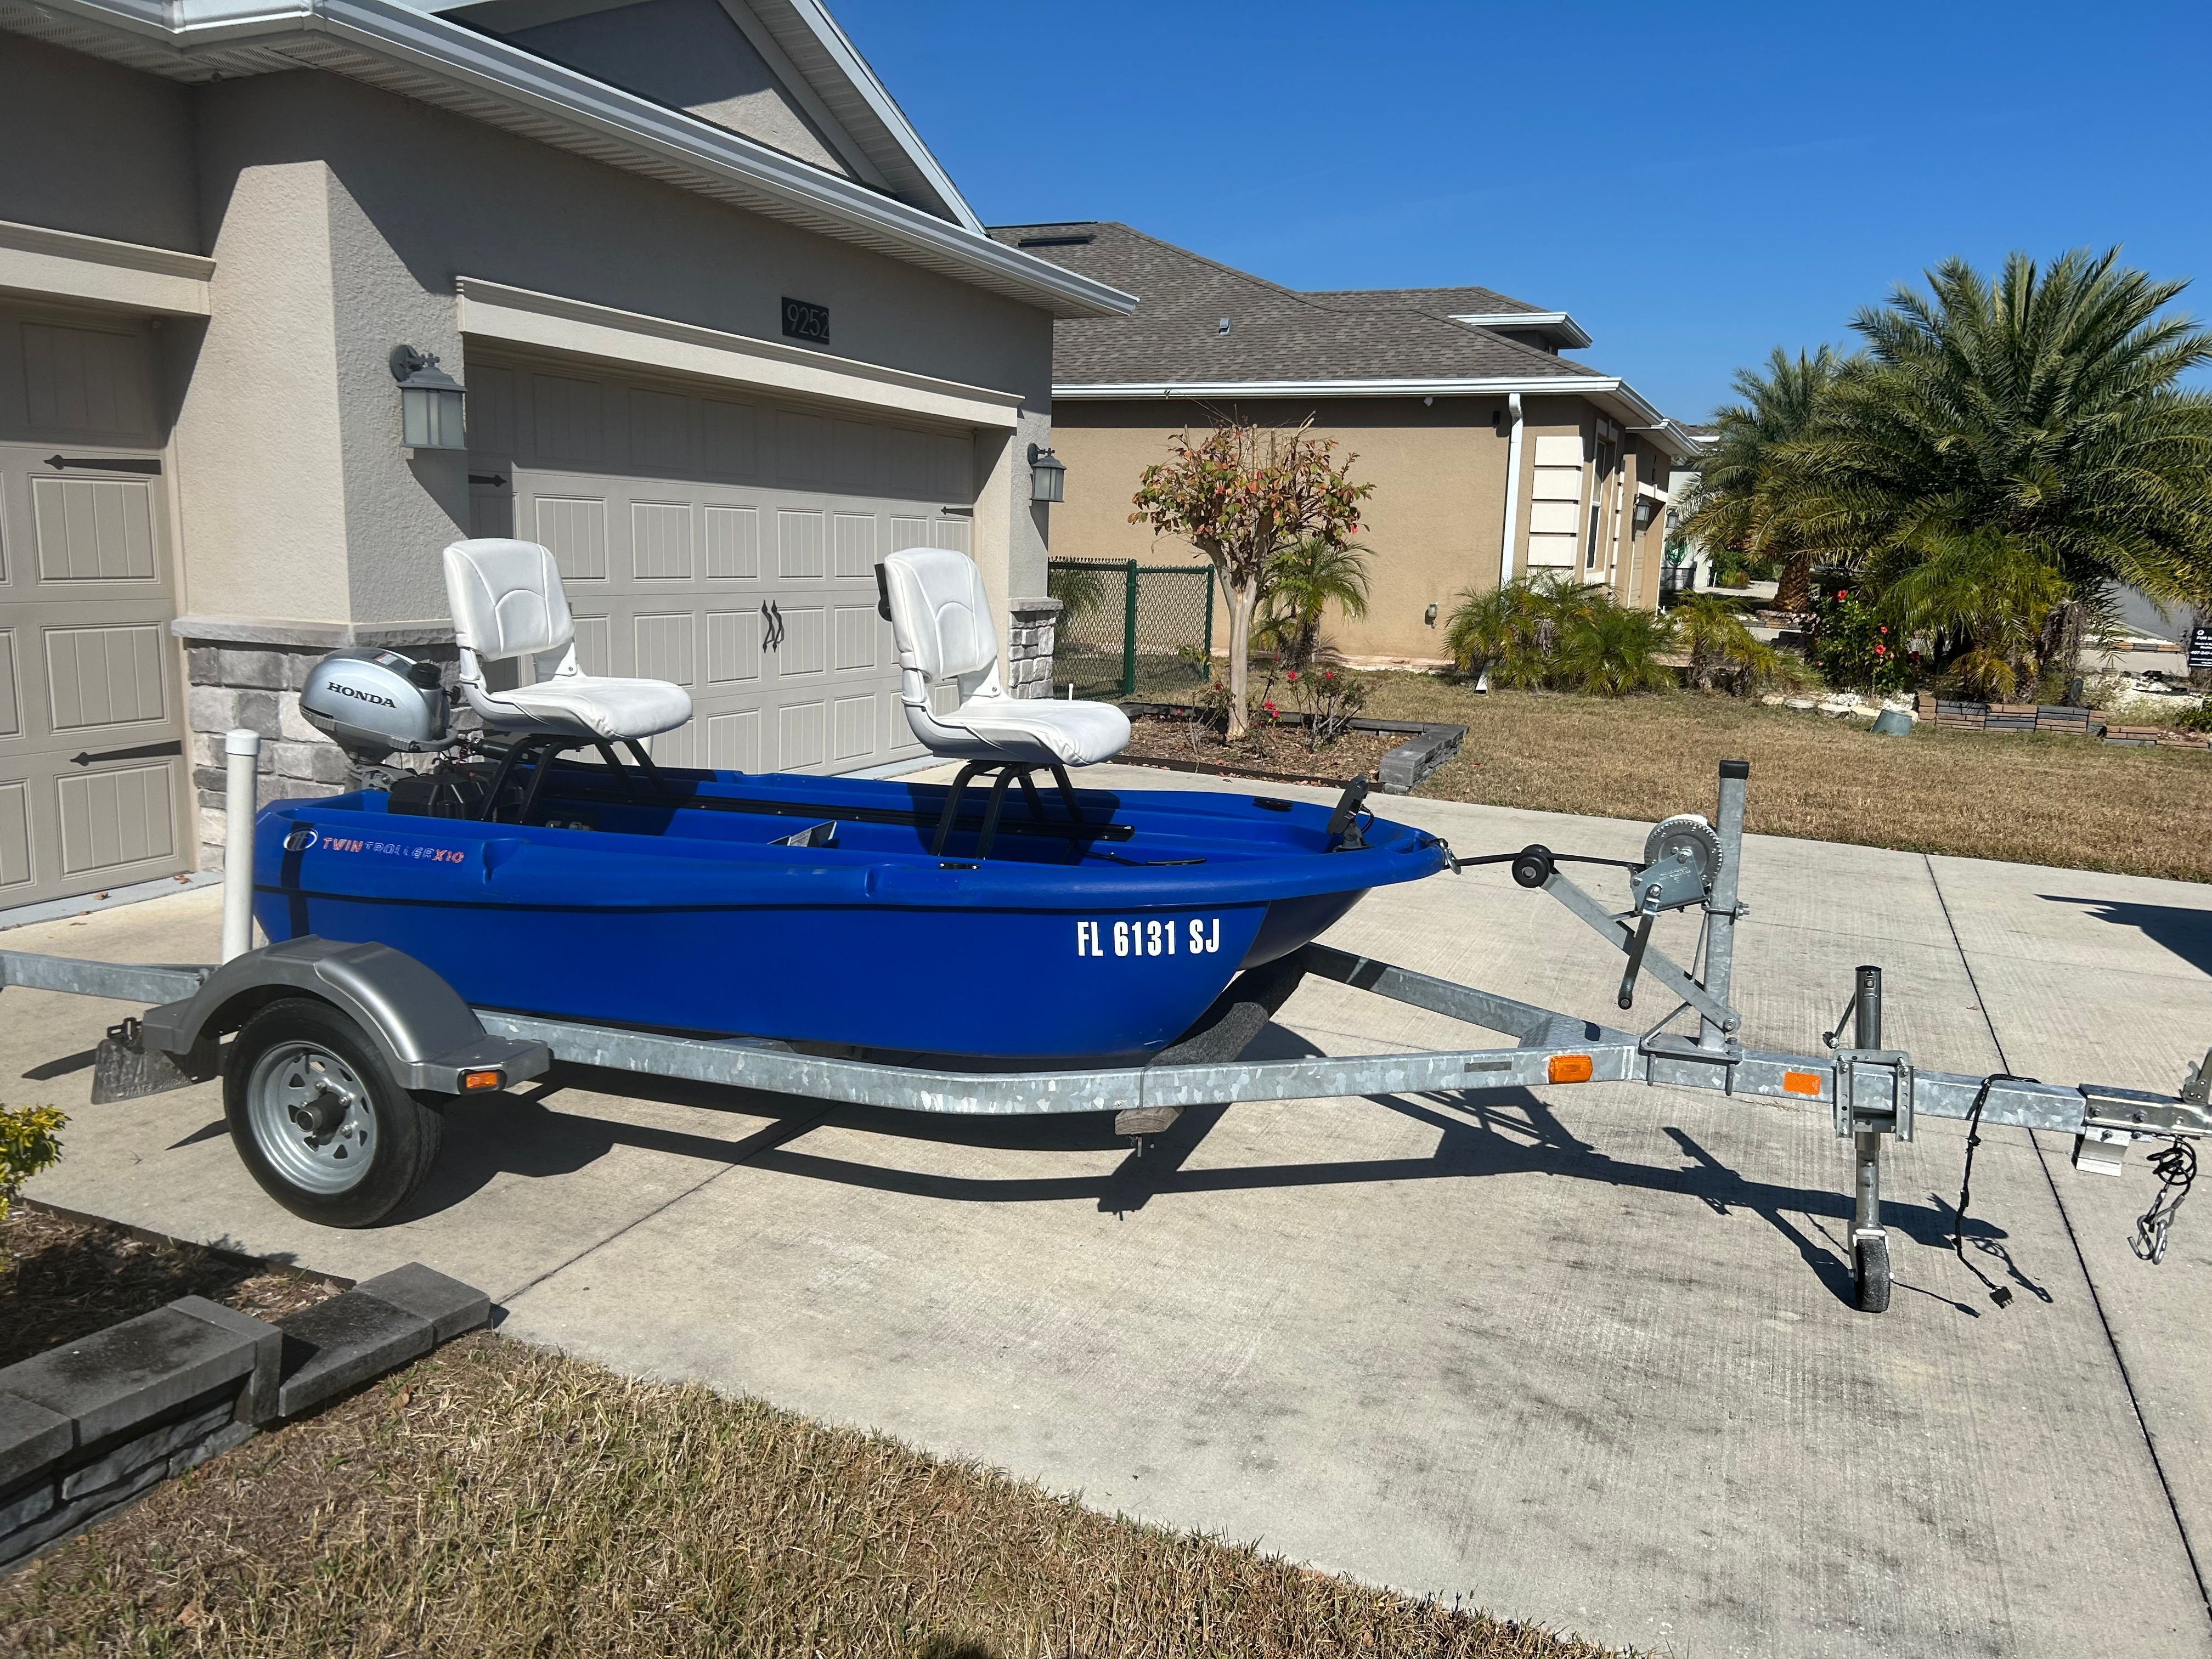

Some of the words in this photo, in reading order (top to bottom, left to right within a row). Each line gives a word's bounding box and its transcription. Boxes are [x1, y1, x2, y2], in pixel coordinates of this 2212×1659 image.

[327, 681, 397, 708] HONDA
[1077, 922, 1103, 956] FL
[1114, 921, 1176, 957] 6131
[1189, 918, 1220, 954] SJ
